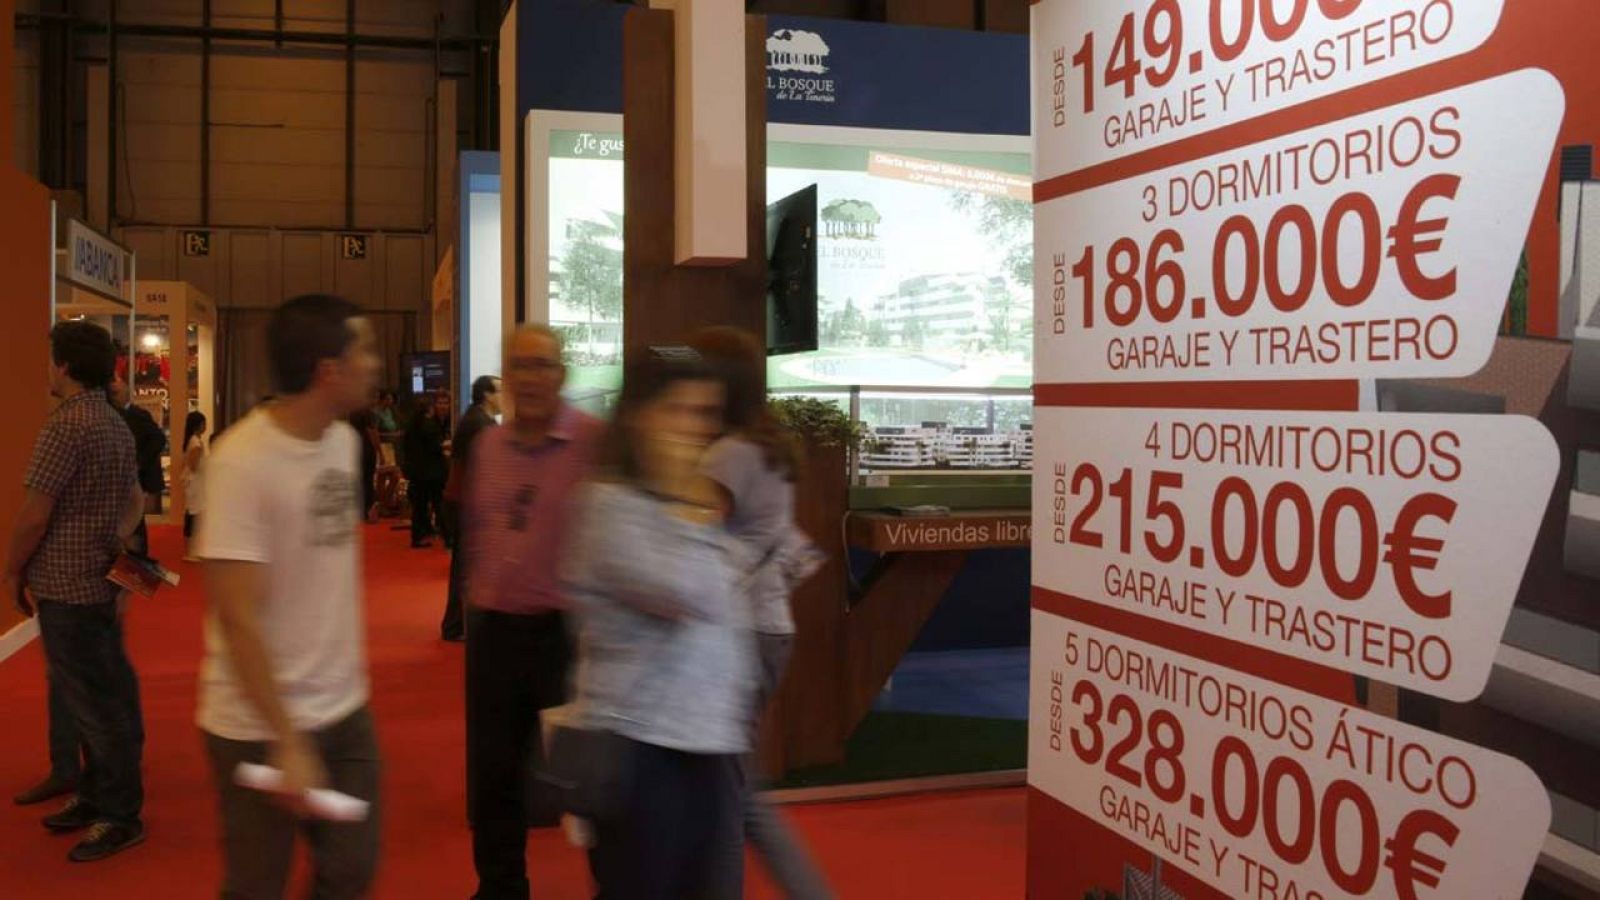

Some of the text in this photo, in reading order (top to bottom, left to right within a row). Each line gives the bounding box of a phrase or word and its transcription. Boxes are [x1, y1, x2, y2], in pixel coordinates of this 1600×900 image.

[779, 77, 835, 92] BOSQUE
[1053, 46, 1066, 127] DESDE
[1072, 0, 1361, 113] 149.0
[1104, 0, 1454, 148] GARAJE Y TRASTERO
[574, 133, 597, 155] ¿Te
[1142, 105, 1462, 222] 3 DORMITORIOS
[1053, 251, 1066, 335] DESDE
[1072, 174, 1461, 328] 186.000€
[1107, 315, 1458, 370] GARAJE Y TRASTERO
[1145, 421, 1462, 482] 4 DORMITORIOS
[884, 520, 990, 545] Viviendas
[1053, 462, 1066, 544] DESDE
[1069, 462, 1458, 619] 215.000€
[1104, 564, 1453, 682] GARAJE Y TRASTERO
[1049, 671, 1063, 752] DESDE
[1065, 632, 1478, 811] 5 DORMITORIOS ÁTICO
[1068, 679, 1461, 900] 328.000€
[1099, 784, 1325, 900] GARAJE Y TR
